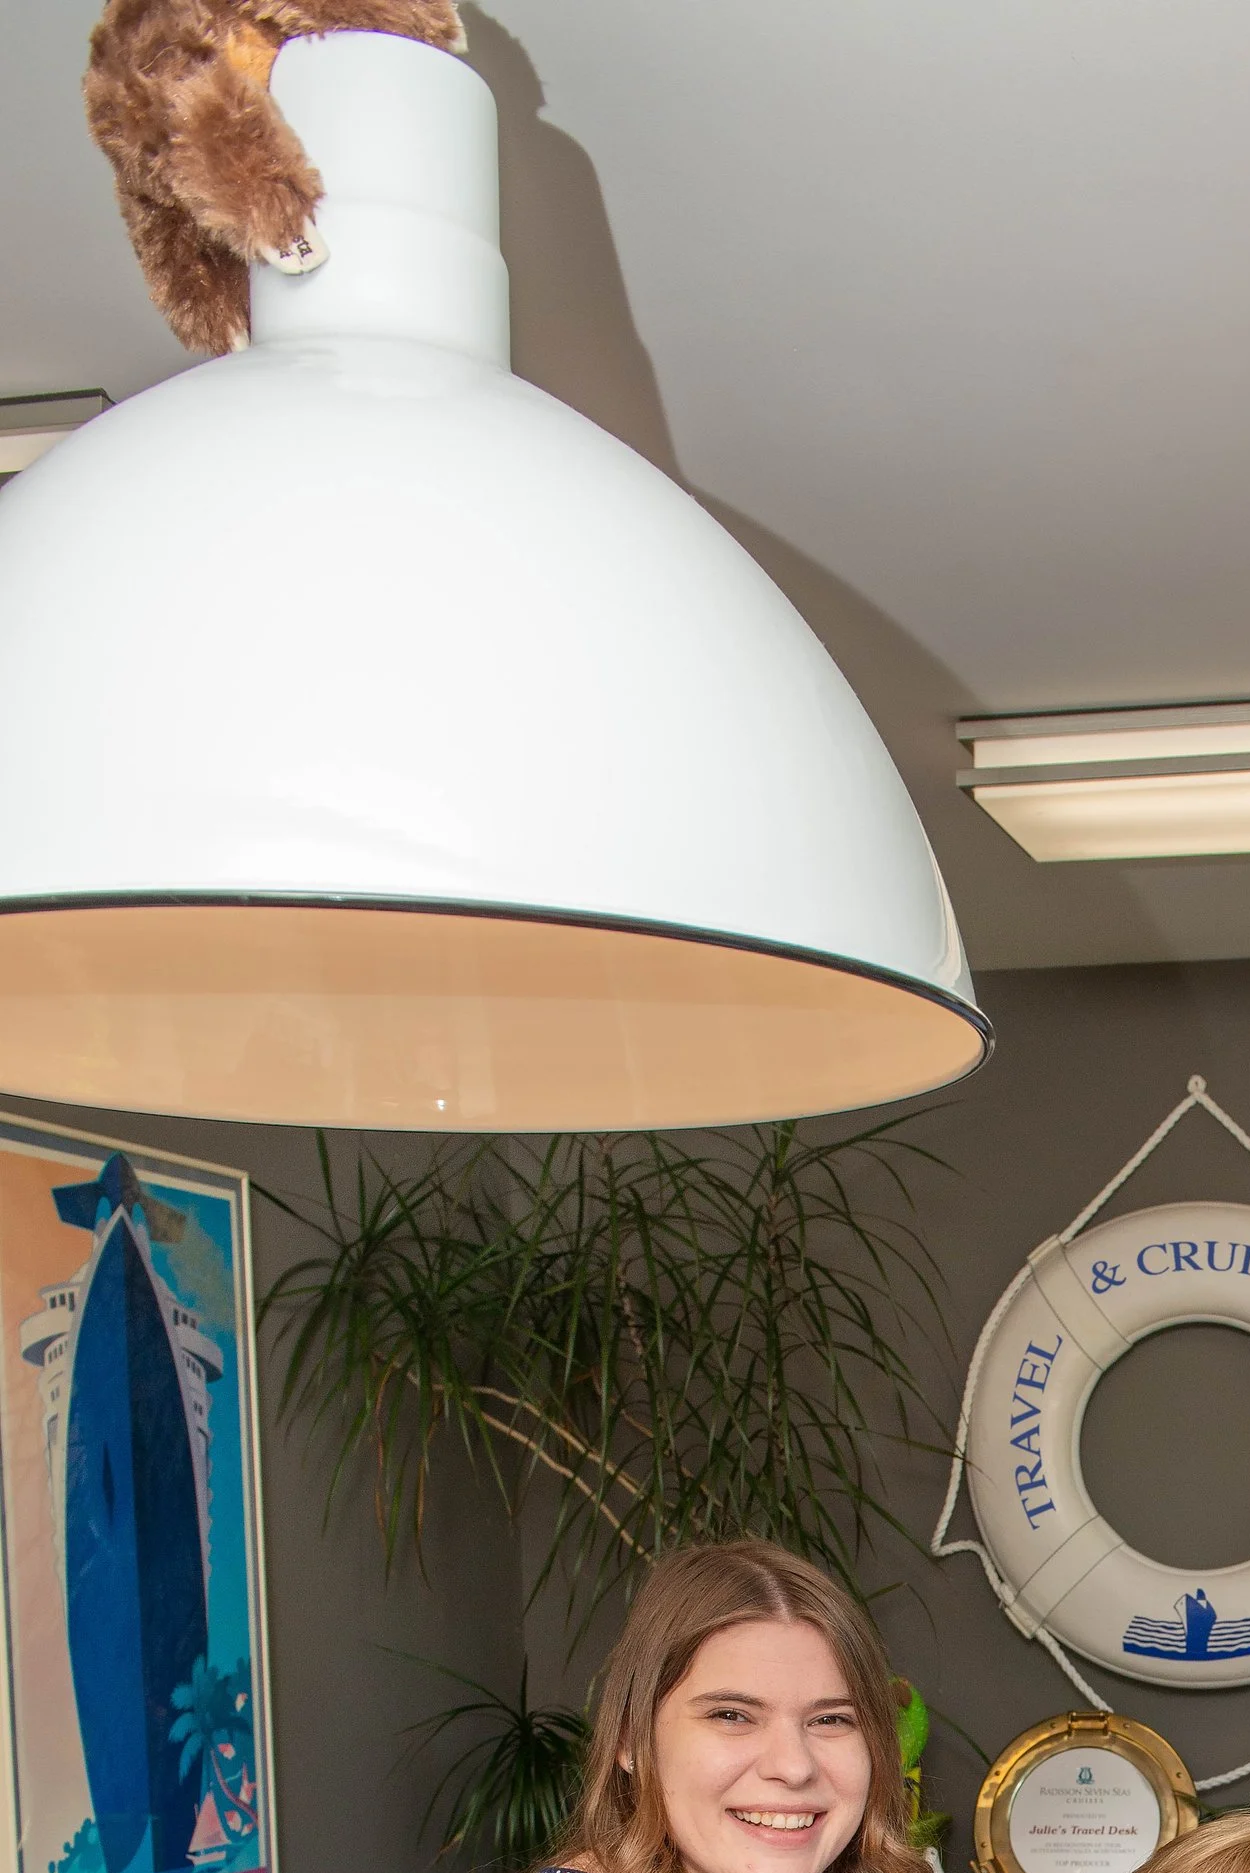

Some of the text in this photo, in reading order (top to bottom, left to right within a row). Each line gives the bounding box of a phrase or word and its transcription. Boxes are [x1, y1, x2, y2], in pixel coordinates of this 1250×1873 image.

[1010, 1334, 1064, 1530] TRAVEL
[1090, 1260, 1126, 1295] &
[1029, 1825, 1139, 1836] Julie's Travel Desk
